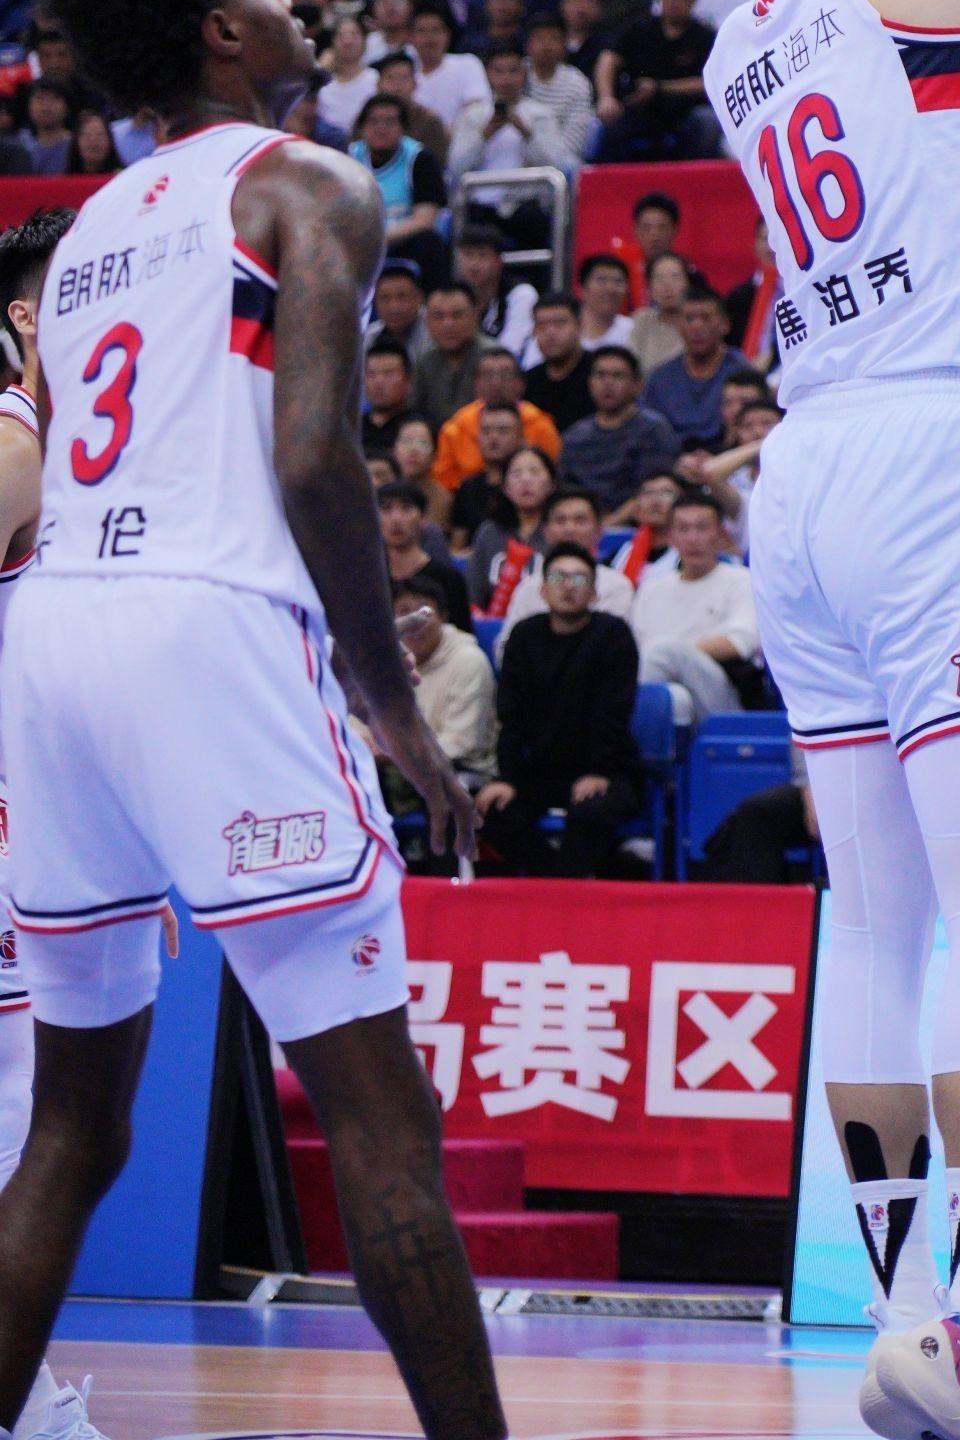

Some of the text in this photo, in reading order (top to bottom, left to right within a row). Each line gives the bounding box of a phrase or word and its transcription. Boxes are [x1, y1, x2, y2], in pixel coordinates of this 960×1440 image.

[724, 7, 845, 129] 朗肽海本
[758, 92, 866, 272] 16
[775, 247, 913, 350] 焦泊乔
[70, 321, 144, 487] 3
